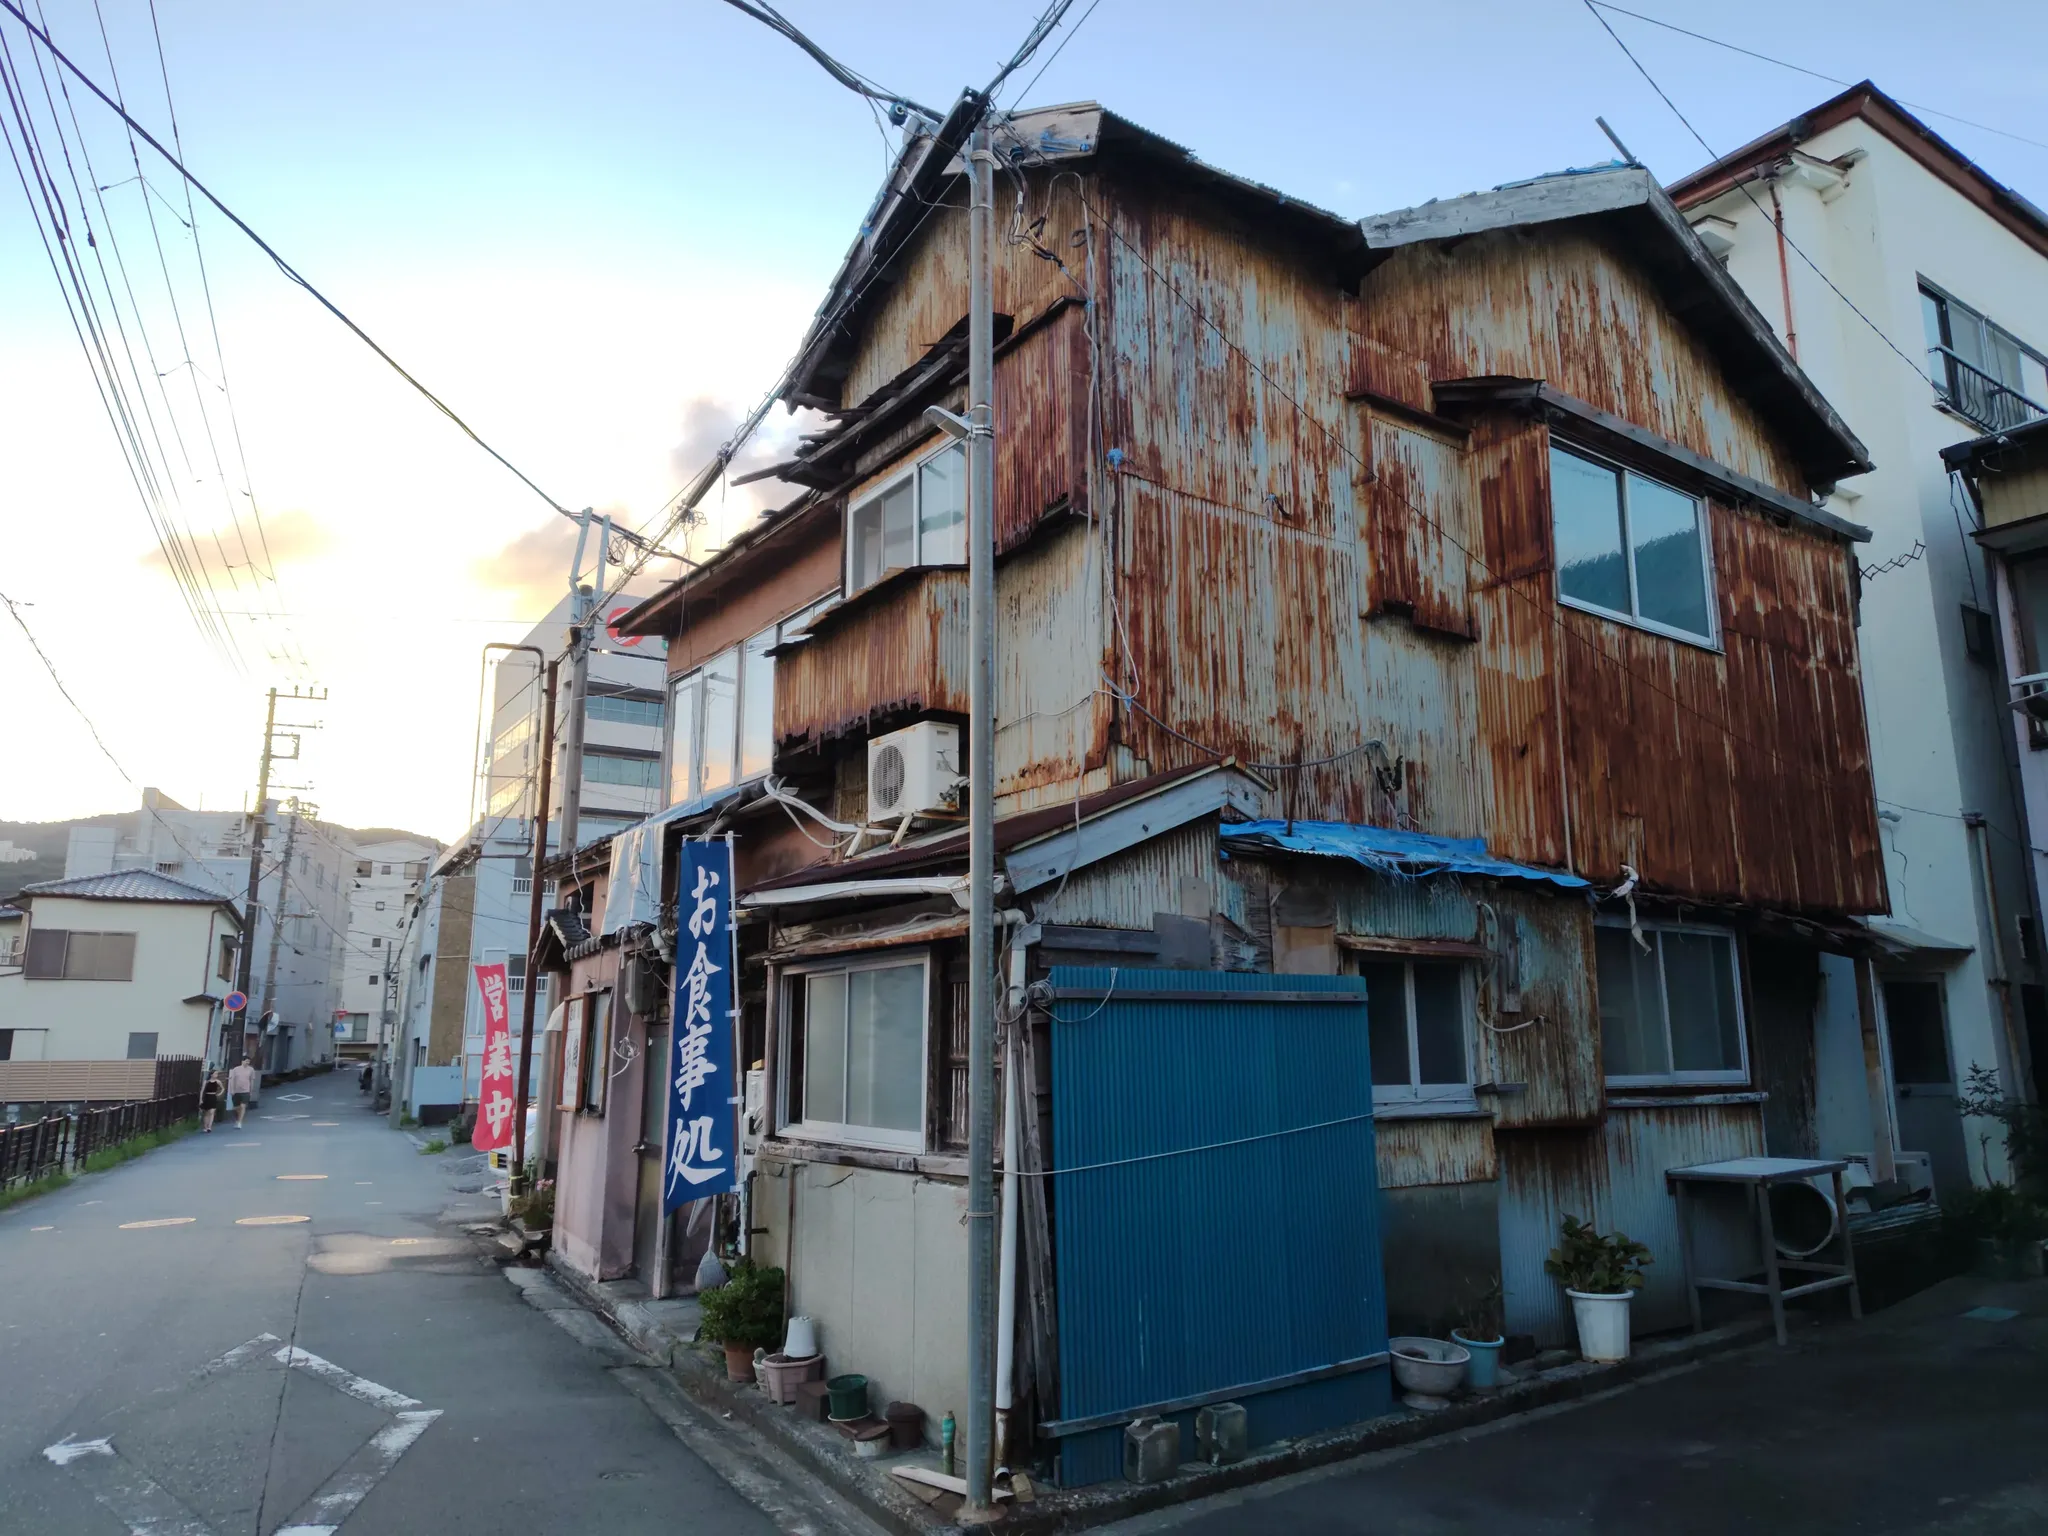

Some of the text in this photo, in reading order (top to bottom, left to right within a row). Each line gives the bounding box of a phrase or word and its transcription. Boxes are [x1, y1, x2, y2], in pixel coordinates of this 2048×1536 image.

[483, 974, 513, 1141] 営業中
[667, 865, 726, 1200] お食事処
